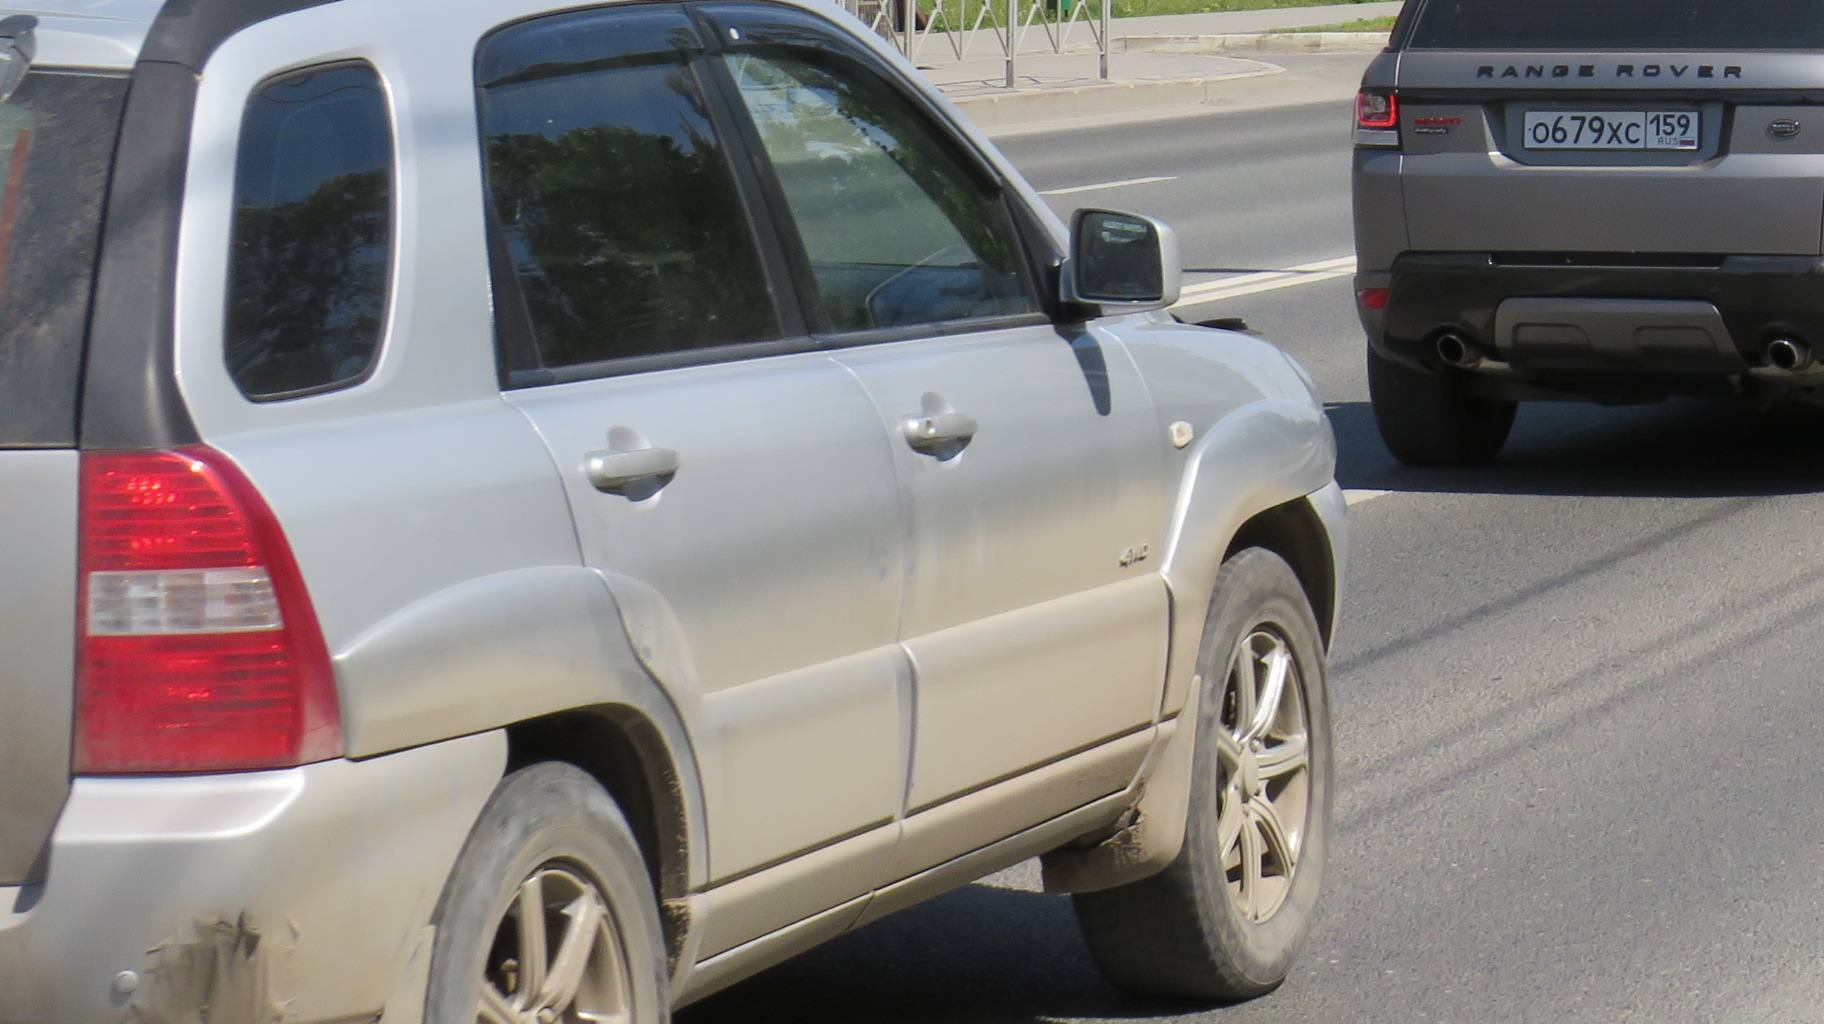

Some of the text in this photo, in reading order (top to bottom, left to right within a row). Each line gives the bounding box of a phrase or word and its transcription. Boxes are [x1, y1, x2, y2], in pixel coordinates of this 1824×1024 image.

[1476, 64, 1743, 78] RANGE ROVER
[1532, 113, 1691, 145] О679ХС 159
[1657, 137, 1679, 146] RUS
